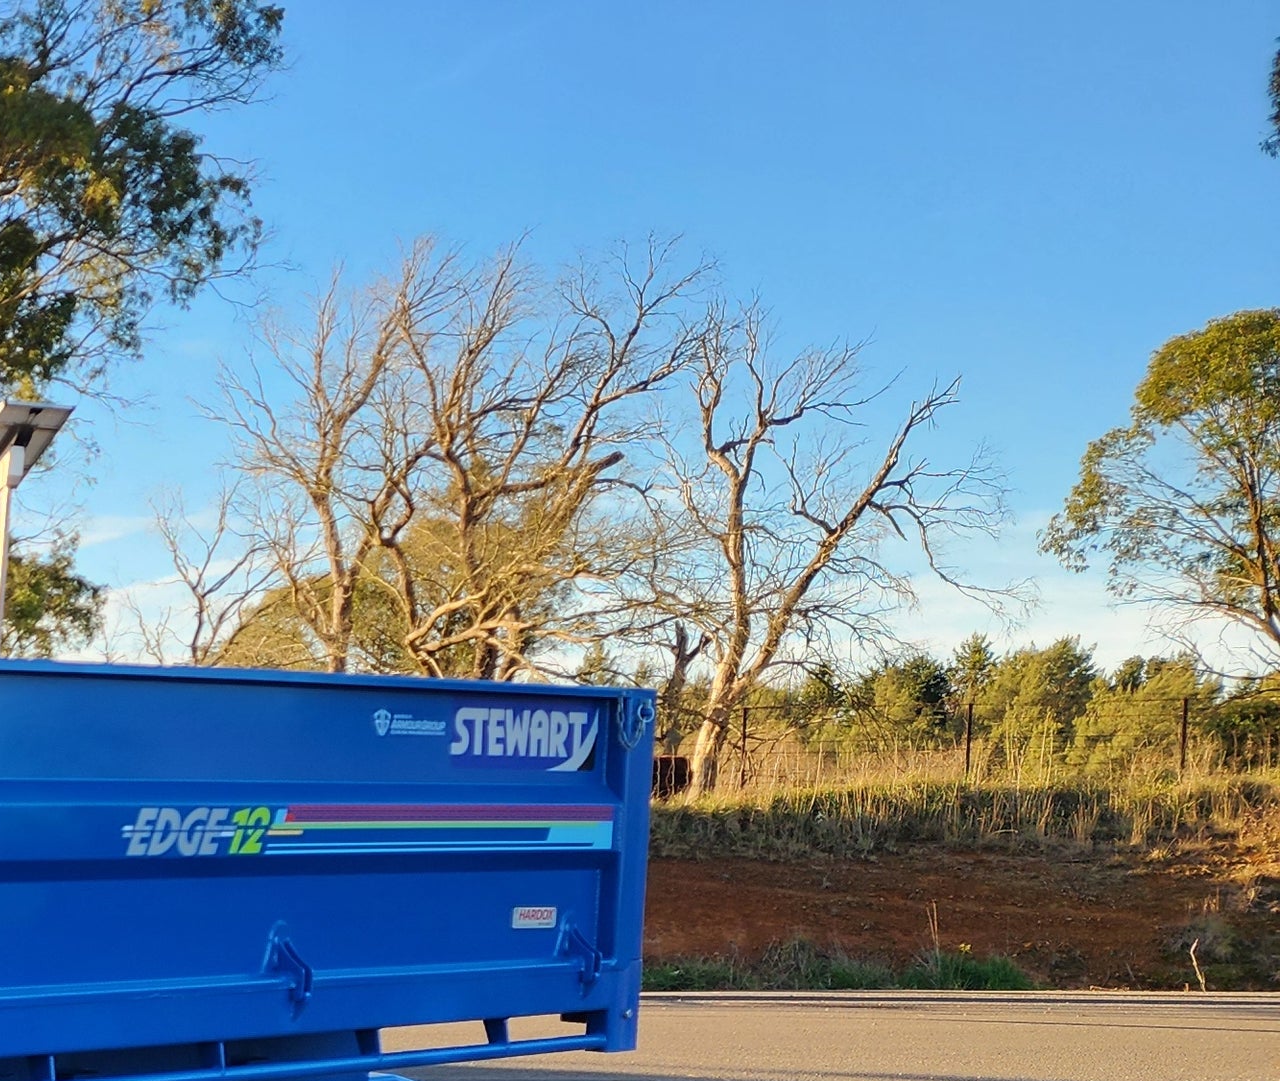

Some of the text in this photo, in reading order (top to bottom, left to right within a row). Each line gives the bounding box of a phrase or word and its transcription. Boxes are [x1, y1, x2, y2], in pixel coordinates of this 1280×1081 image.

[450, 703, 600, 772] STEWART
[125, 806, 271, 857] EDGE 12
